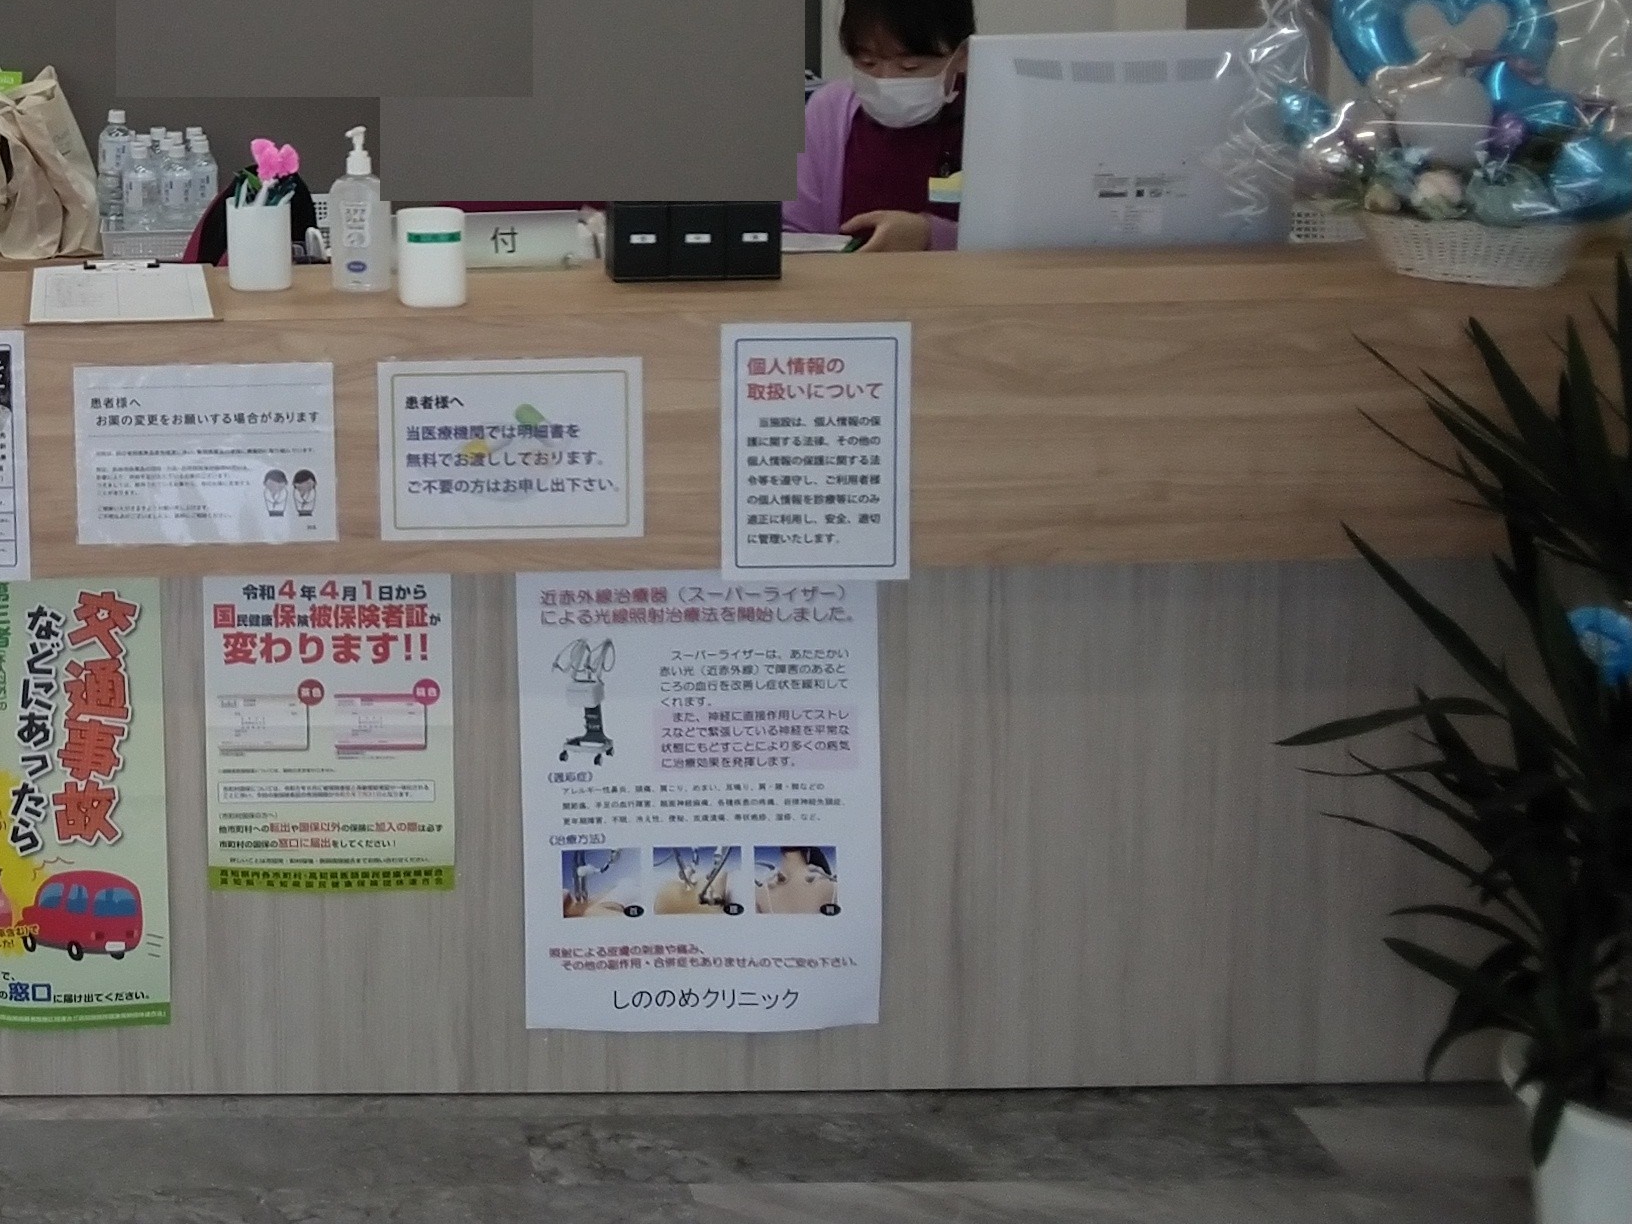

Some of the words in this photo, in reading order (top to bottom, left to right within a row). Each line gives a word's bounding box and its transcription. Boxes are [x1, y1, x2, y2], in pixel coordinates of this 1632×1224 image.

[490, 226, 518, 254] 付
[747, 357, 845, 375] 個人情報の
[747, 382, 884, 401] 取扱いについて
[90, 397, 141, 409] 患者様へ
[405, 395, 464, 410] 患者様へ
[96, 411, 319, 427] お薬の変更をお願いする場合があります
[406, 424, 581, 441] 当医療機関では明細書を
[406, 450, 603, 468] 無料でお渡ししております。
[407, 478, 619, 494] ご不要の方はお申し出下さい。
[747, 533, 840, 544] に管理いたします。
[242, 580, 428, 602] 令和4年4月1日から
[539, 585, 847, 606] 近赤外線治療器（スーパーライザー）
[213, 603, 441, 629] 国民健康保険被保険者証が
[541, 606, 854, 626] による光線照射治療法を開始しました。
[223, 632, 429, 665] 変わります!!
[671, 649, 849, 661] スーパーライザーは、あたたかい
[660, 678, 849, 692] ころの血行を改善し症状を緩和して
[661, 696, 712, 707] くれます。
[53, 591, 138, 843] 交通事故
[673, 709, 850, 723] また、神経に直接作用してストレ
[13, 605, 61, 852] などにあったら
[661, 740, 851, 754] 状態にもどすことにより多くの病気
[661, 756, 796, 769] に治療効果を発揮します。
[612, 988, 800, 1011] しののめクリニック
